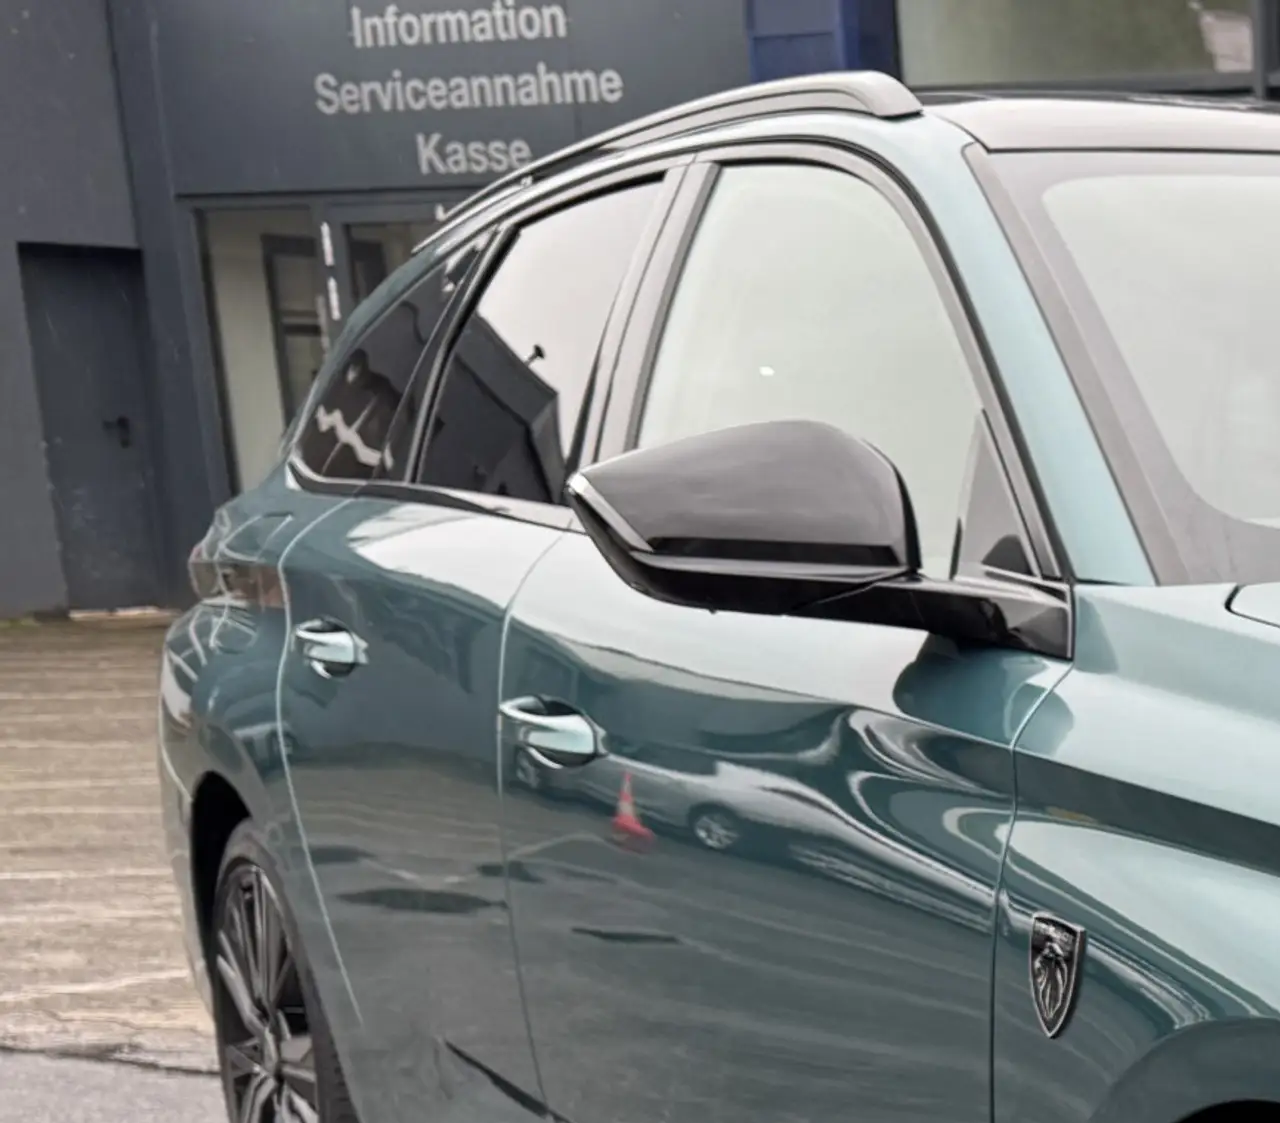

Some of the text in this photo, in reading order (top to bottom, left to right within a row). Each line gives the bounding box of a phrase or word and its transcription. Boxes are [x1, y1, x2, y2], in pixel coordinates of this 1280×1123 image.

[351, 0, 567, 48] Information
[314, 61, 624, 115] Serviceannahme
[416, 132, 533, 175] Kasse
